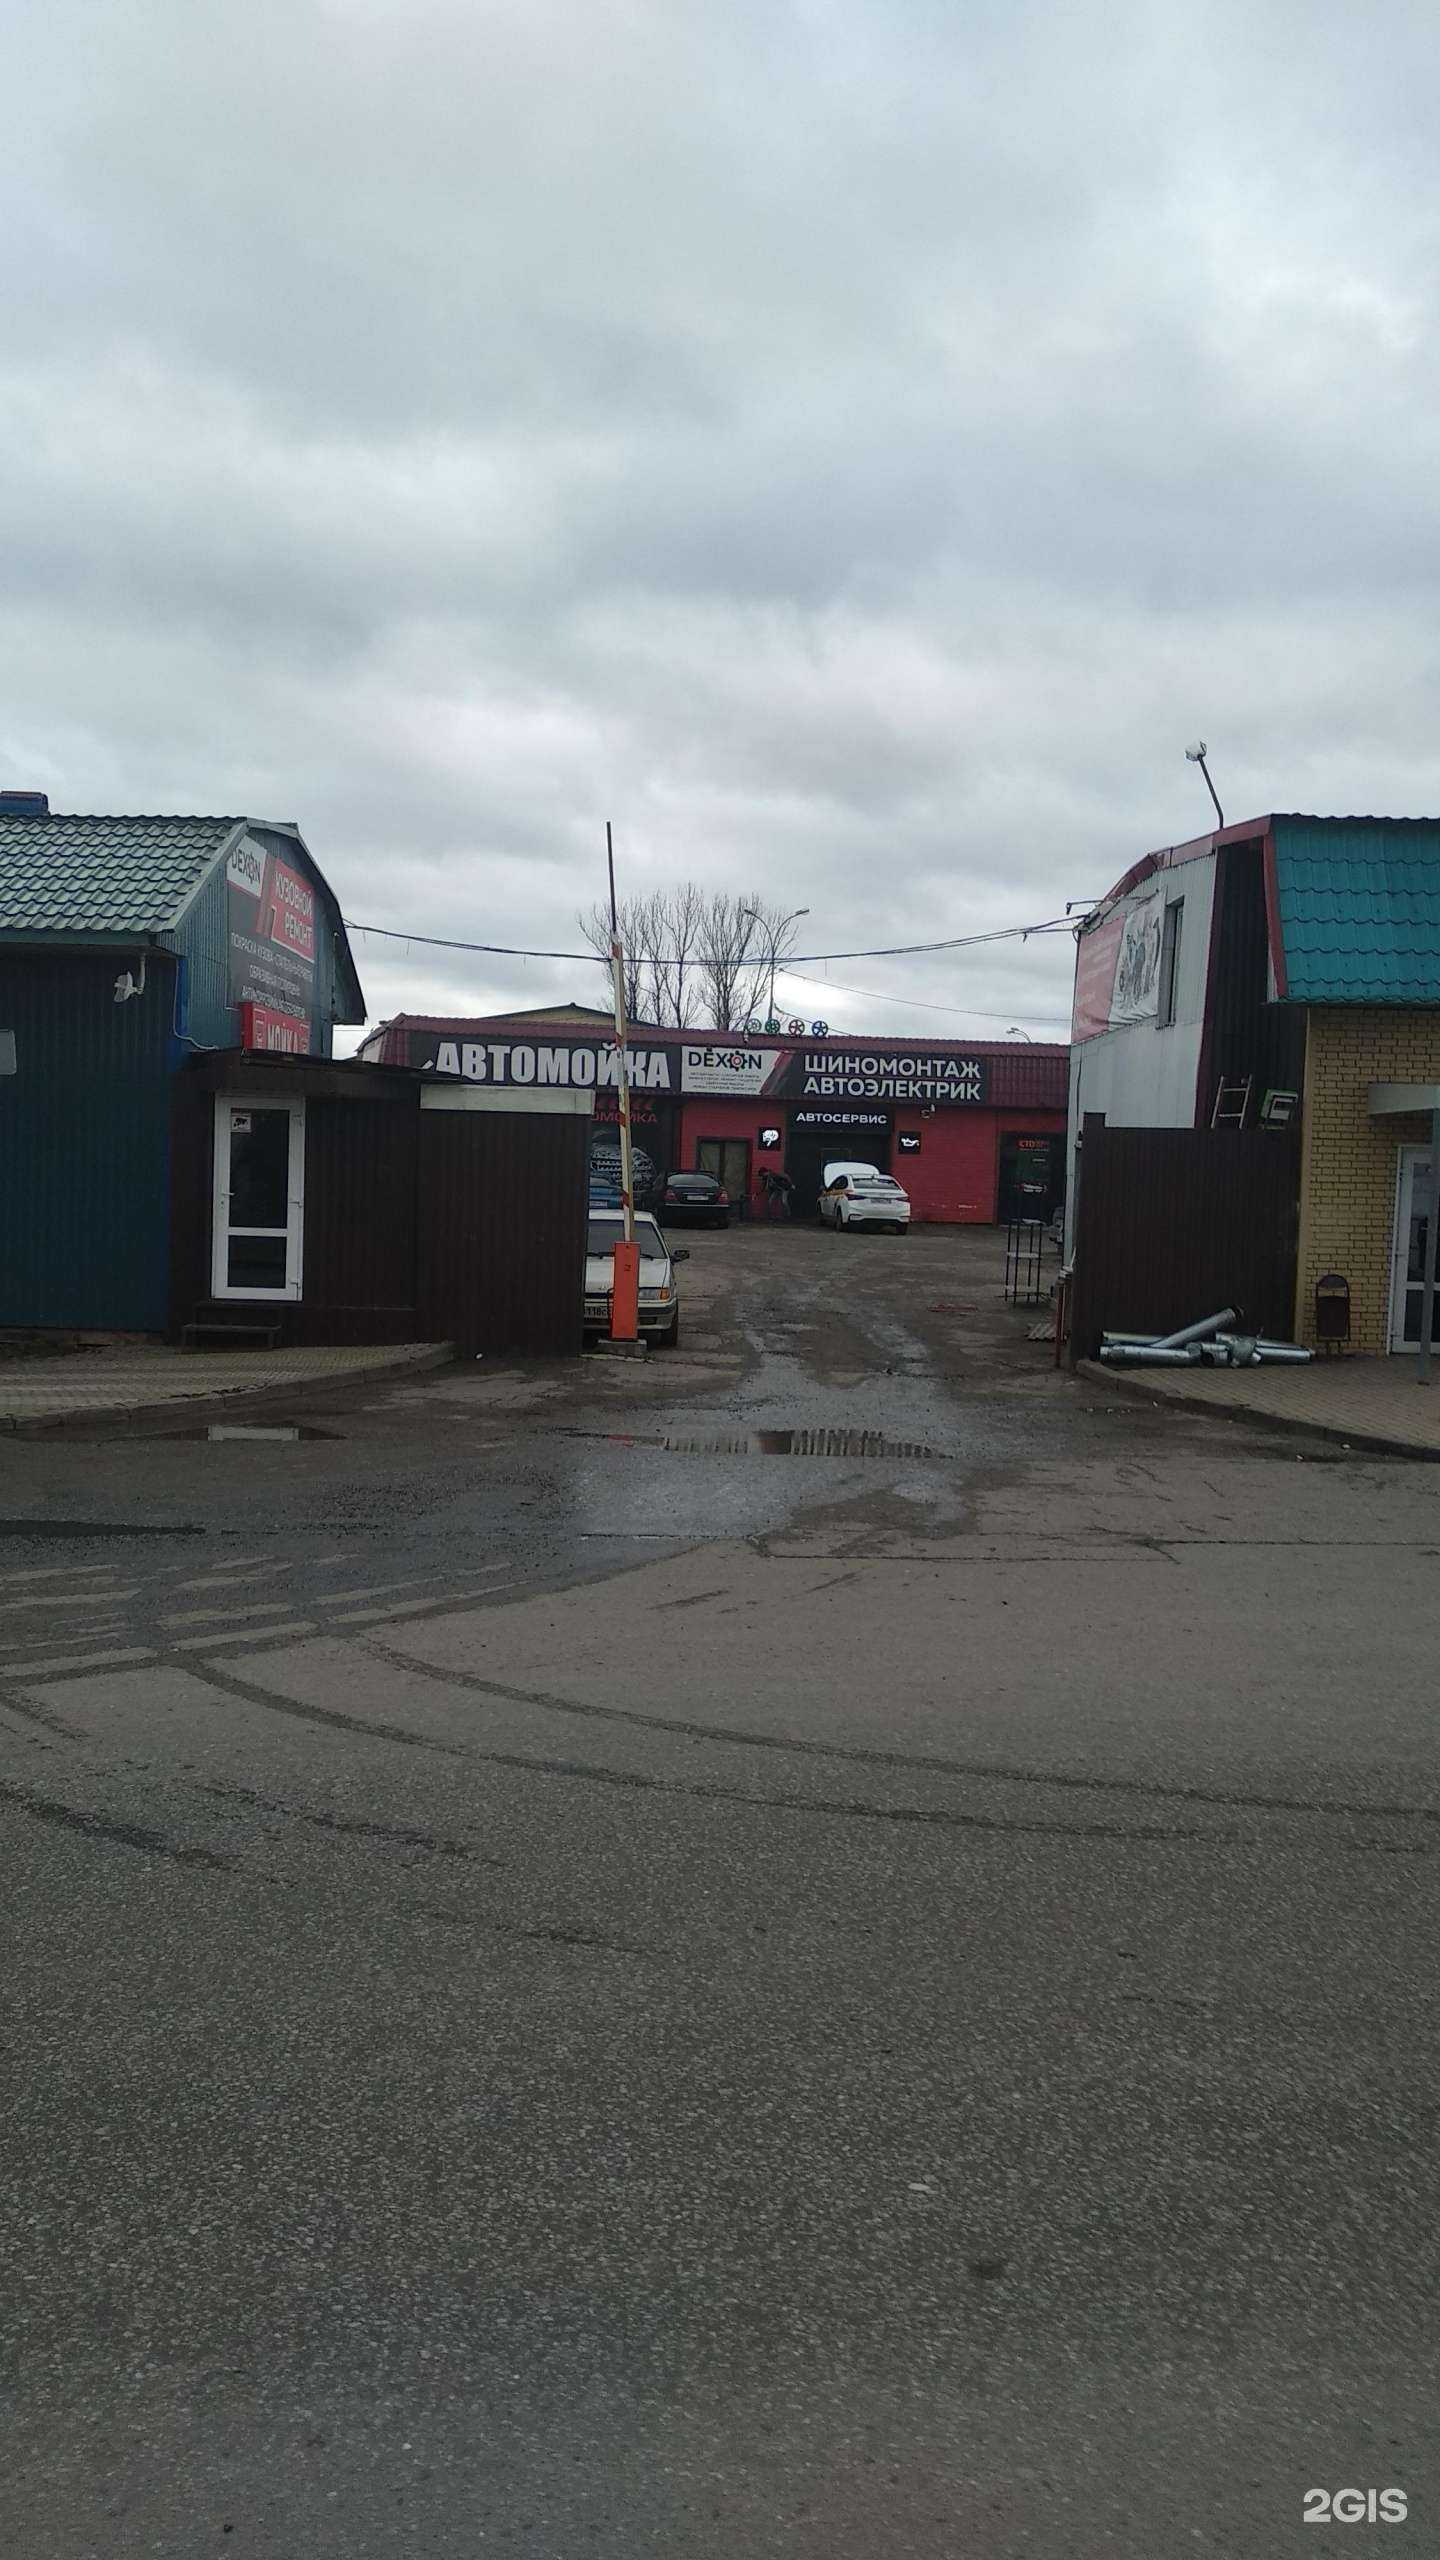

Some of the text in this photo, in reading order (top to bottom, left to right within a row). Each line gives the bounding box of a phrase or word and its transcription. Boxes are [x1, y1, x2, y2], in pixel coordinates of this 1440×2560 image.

[275, 871, 312, 919] КУЗОВНОЙ
[284, 912, 313, 949] РЕМОНТ
[436, 1042, 671, 1088] АВТОМОЙКА
[804, 1054, 981, 1079] ШИНОМОНТАЖ
[803, 1077, 981, 1100] АВТОЭЛЕКТРИК
[796, 1112, 887, 1124] АВТОСЕРВИС
